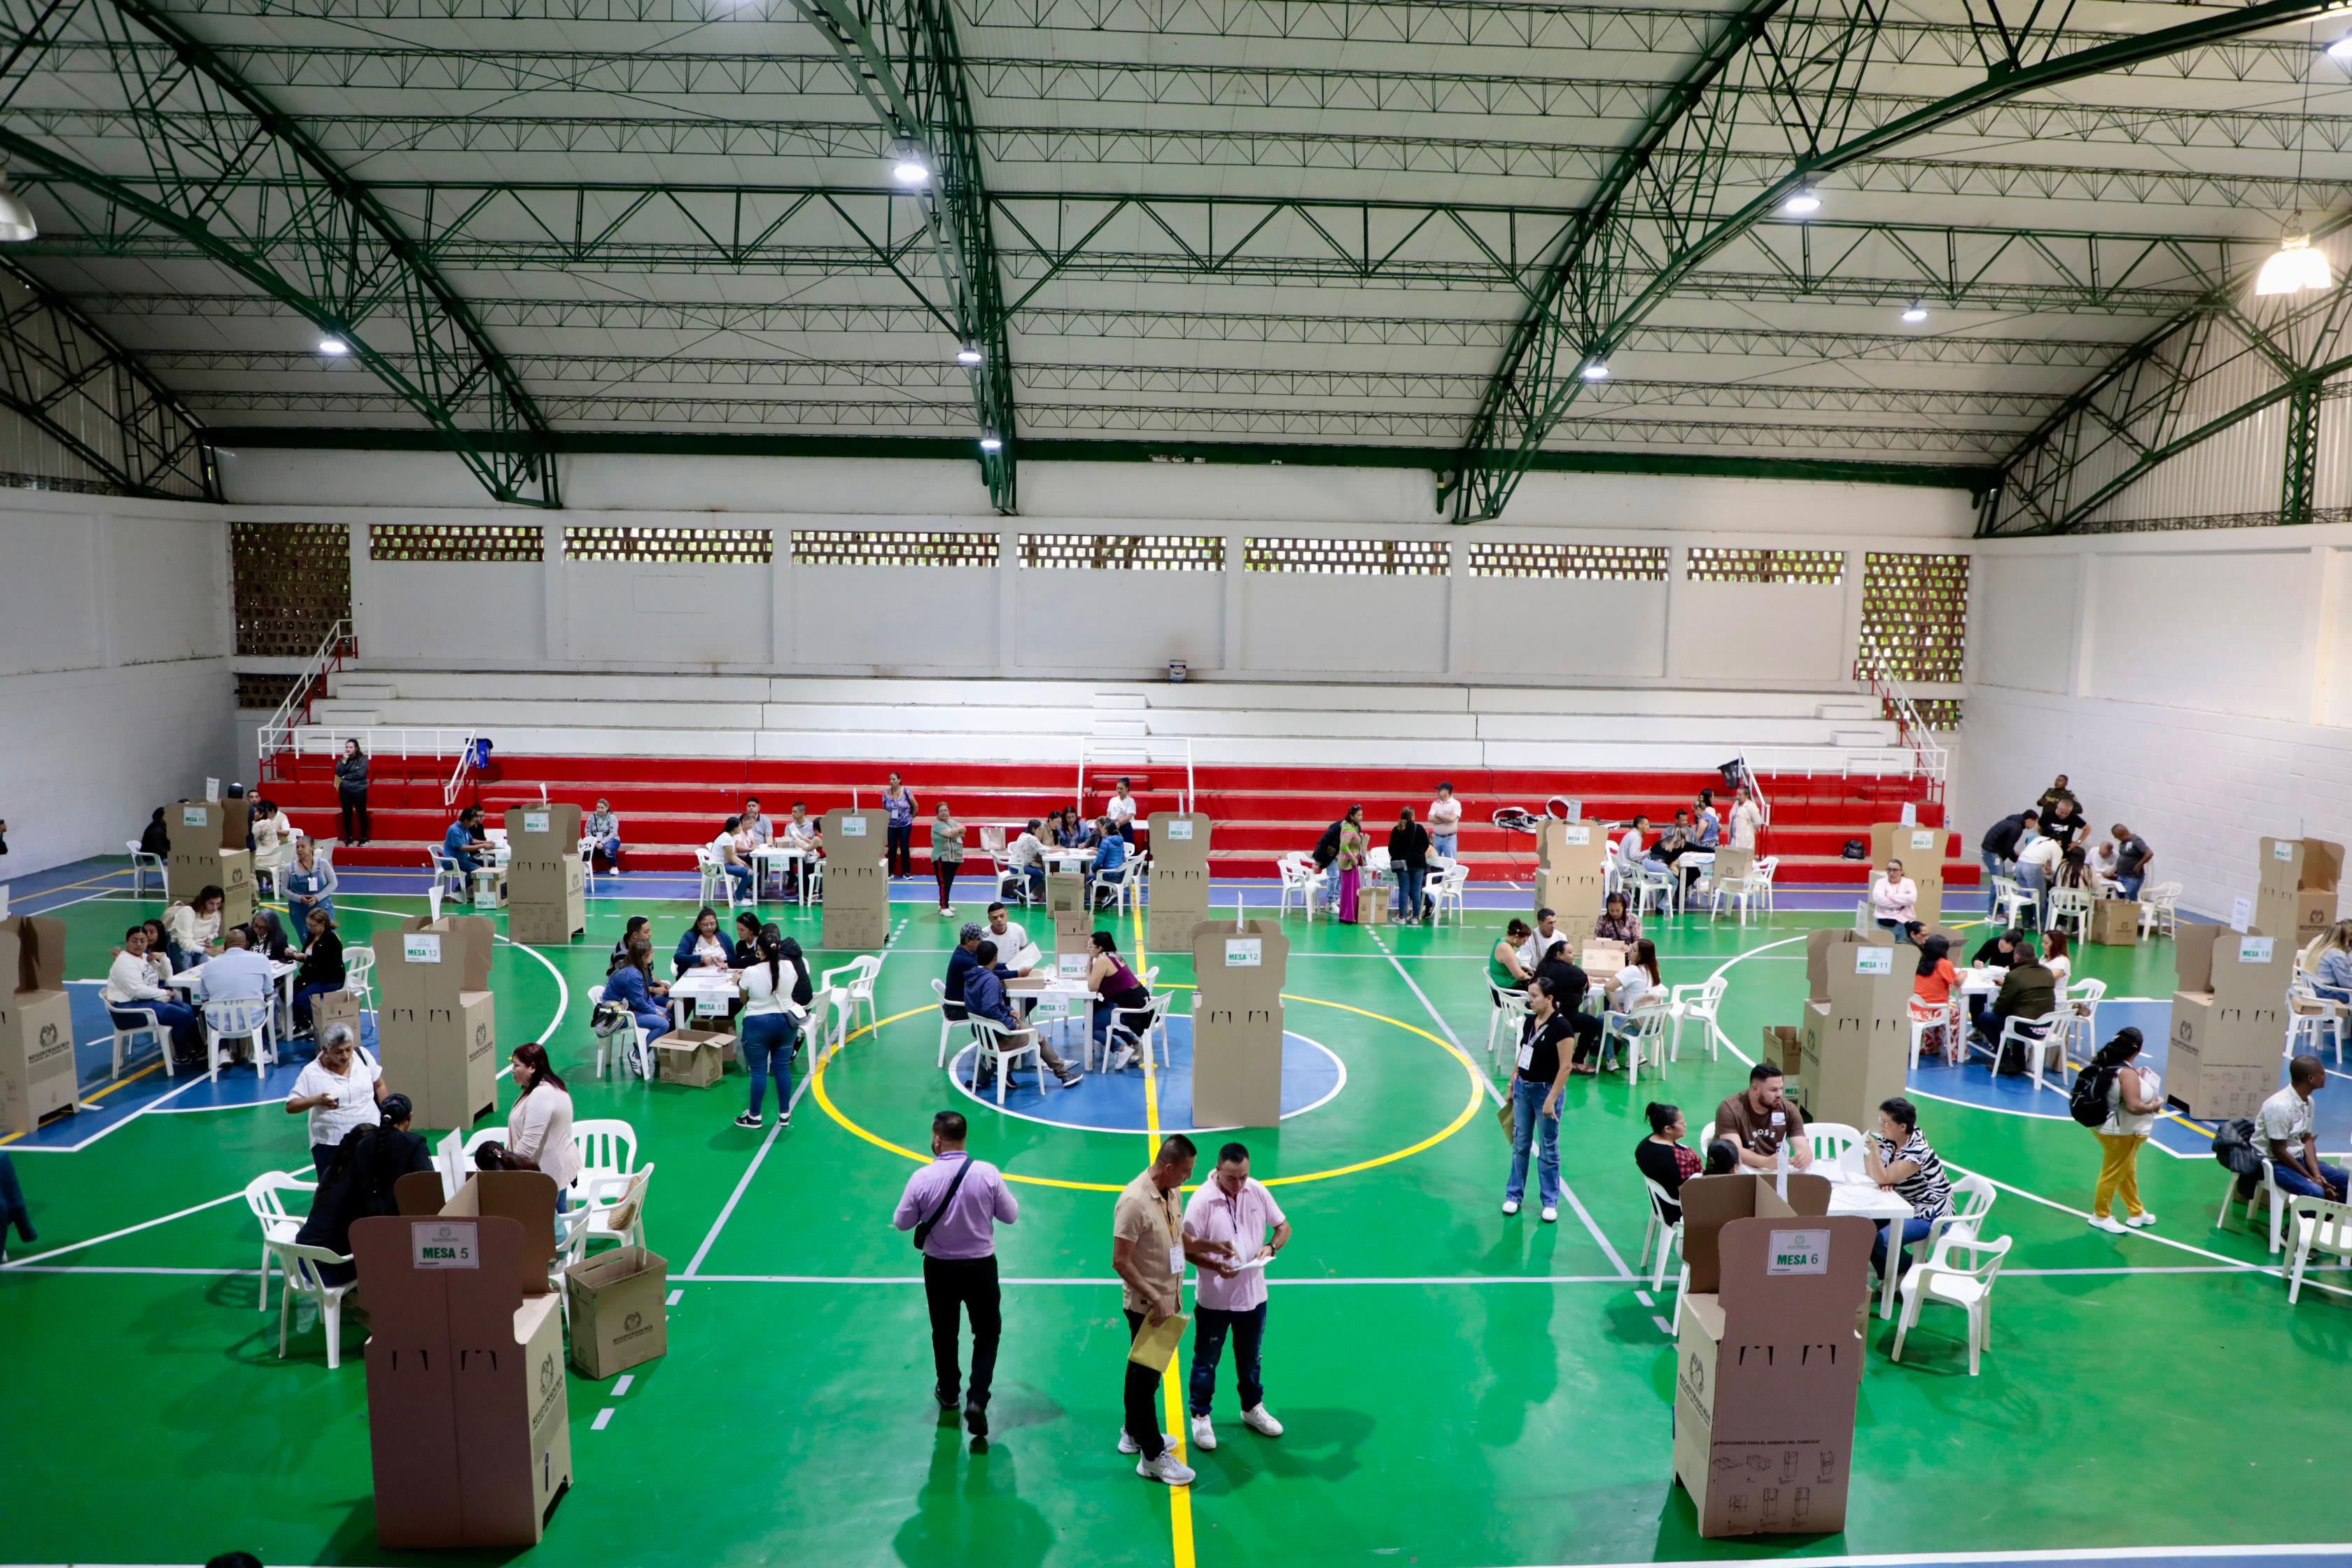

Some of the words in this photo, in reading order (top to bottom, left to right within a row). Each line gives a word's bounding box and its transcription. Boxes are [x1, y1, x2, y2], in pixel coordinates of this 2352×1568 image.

[1752, 1128, 1776, 1138] BOSS
[423, 1247, 456, 1259] MESA
[461, 1247, 469, 1259] 5
[1777, 1254, 1807, 1266] MESA
[1811, 1254, 1819, 1264] 6
